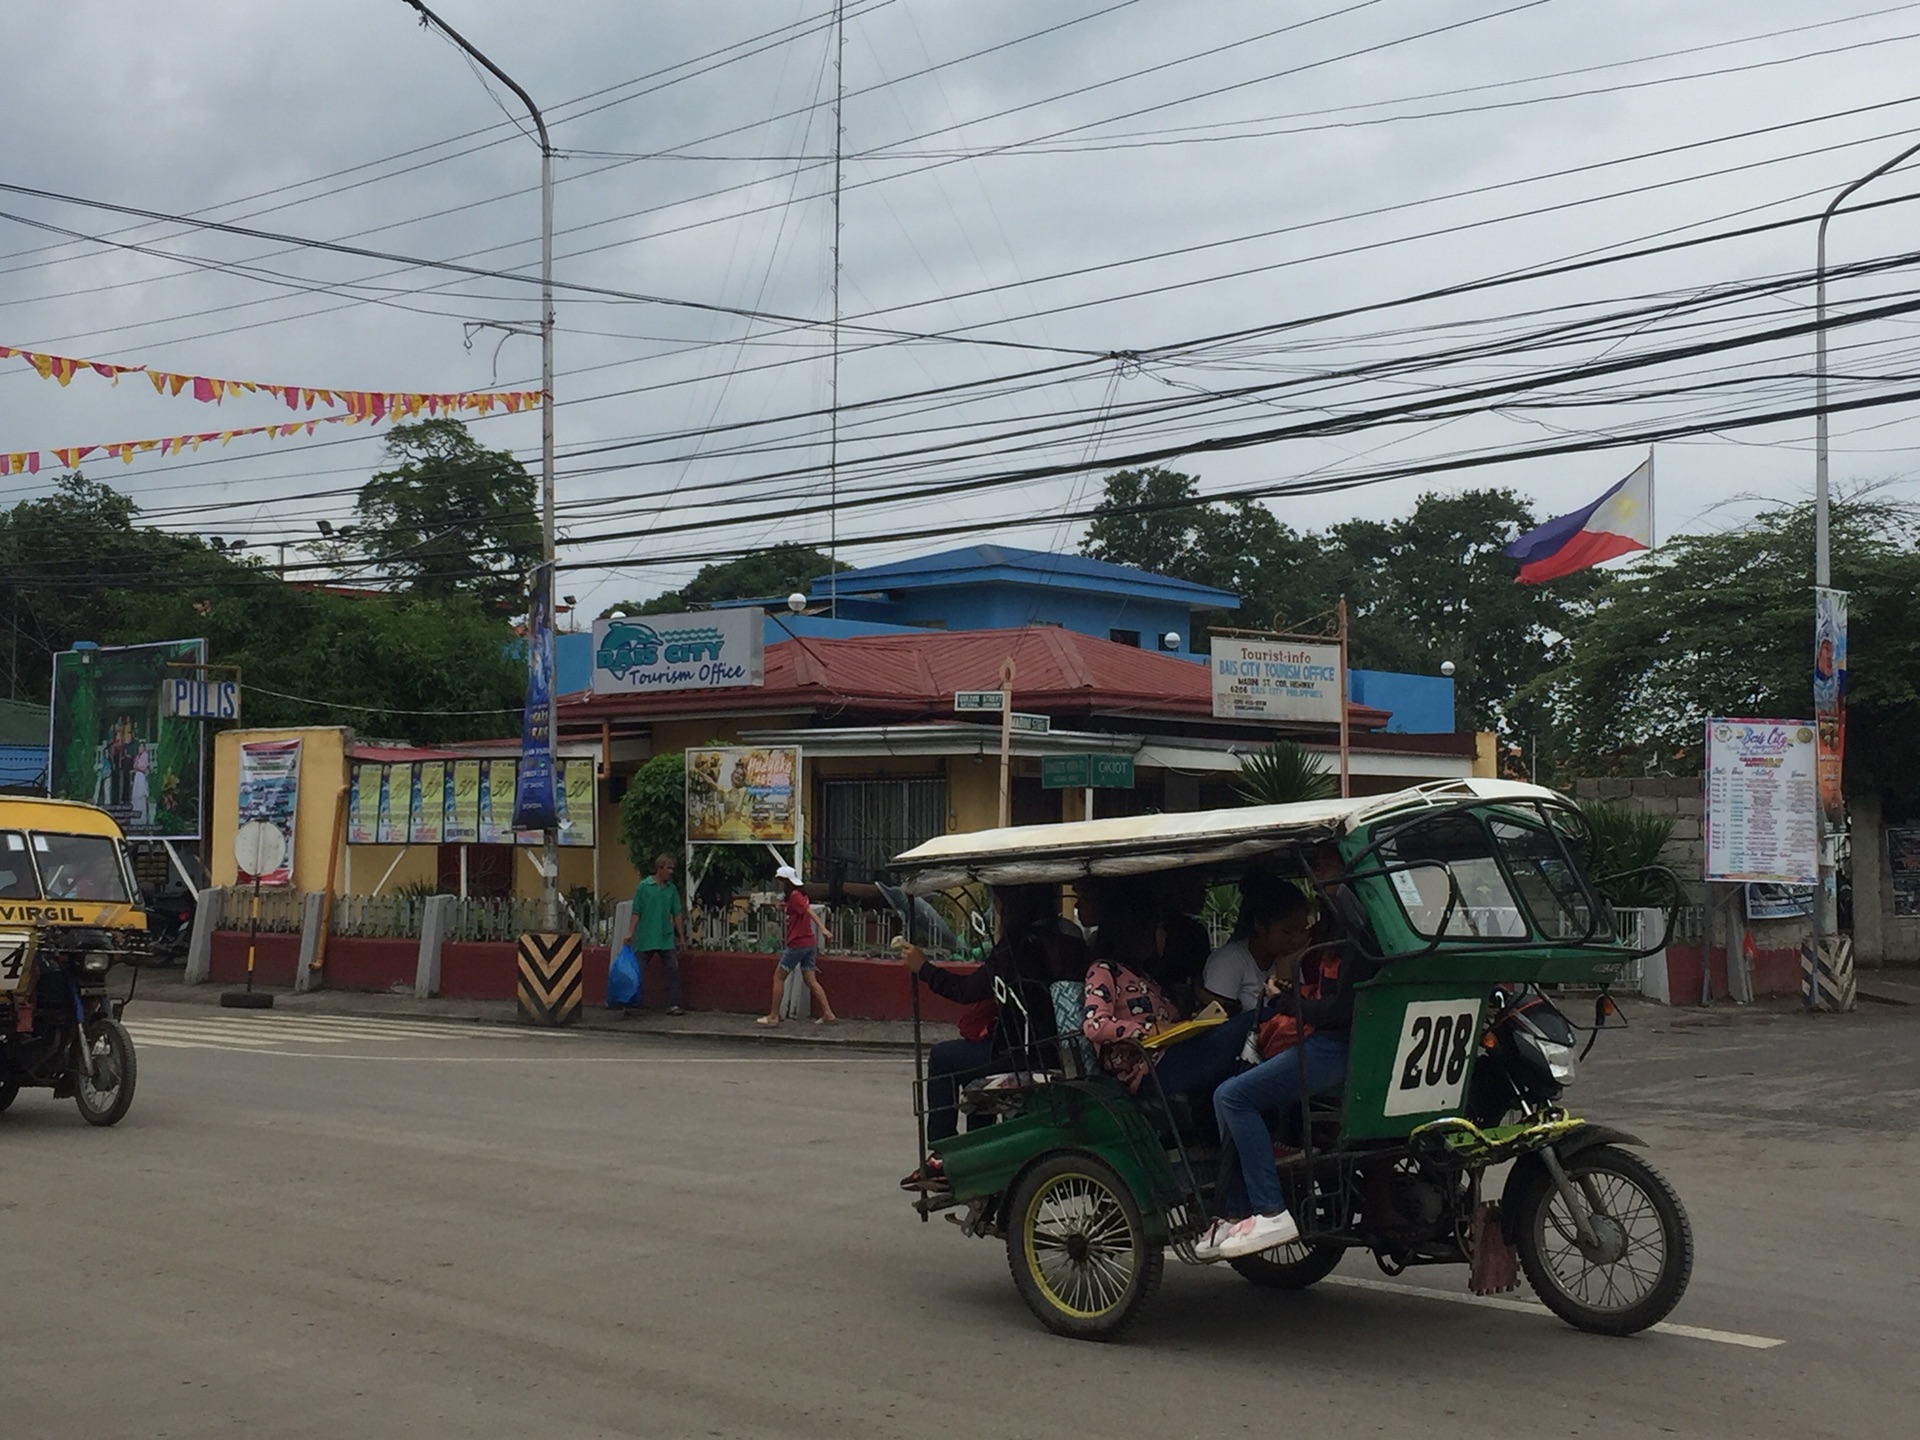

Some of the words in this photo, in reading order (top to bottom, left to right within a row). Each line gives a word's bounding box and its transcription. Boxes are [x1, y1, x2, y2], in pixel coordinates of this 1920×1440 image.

[597, 644, 659, 669] BAIS
[664, 640, 725, 664] CITY
[629, 666, 695, 686] Tourism
[699, 663, 747, 686] Office
[1219, 659, 1238, 676] BAIS
[1240, 660, 1261, 677] CITY
[1264, 662, 1300, 680] TOURISM
[1303, 665, 1335, 682] OFFICE
[176, 680, 236, 719] PULIS
[1230, 686, 1248, 694] 6206
[1268, 687, 1283, 696] CITY
[0, 906, 84, 922] VIRGIL
[1, 941, 25, 979] 4
[1400, 1013, 1473, 1090] 208
